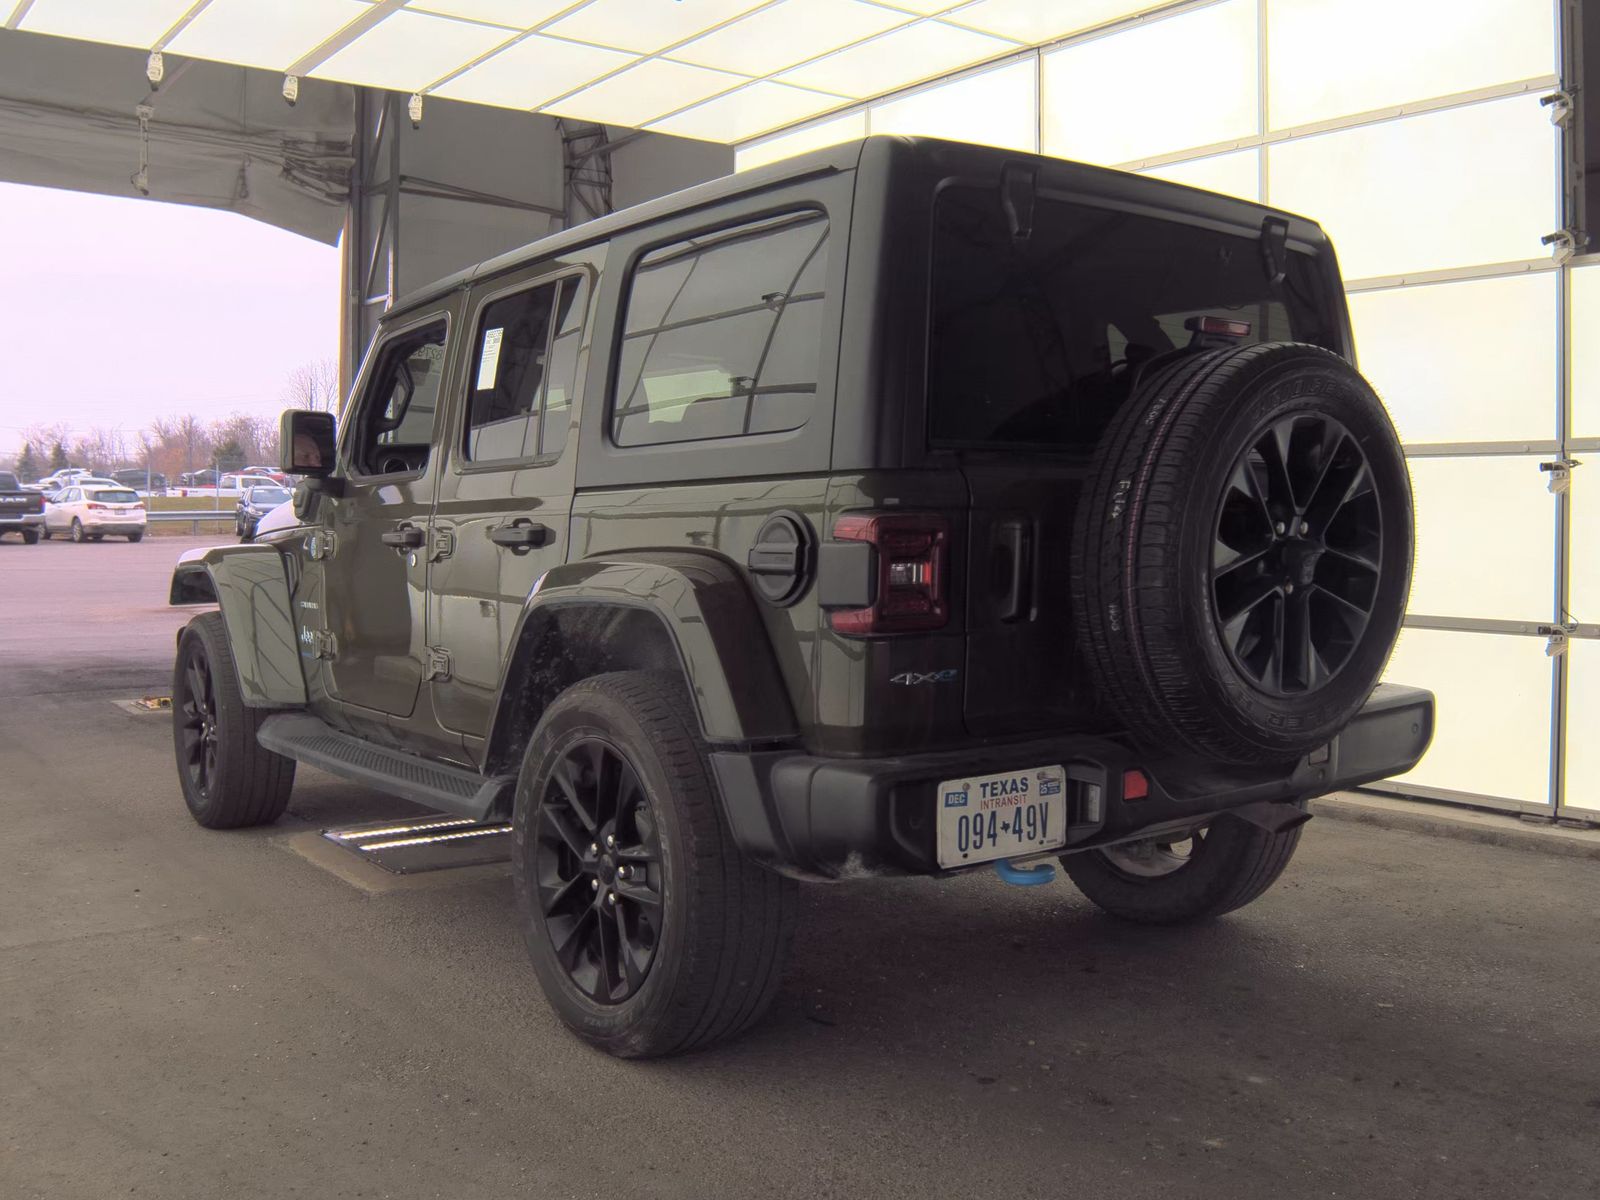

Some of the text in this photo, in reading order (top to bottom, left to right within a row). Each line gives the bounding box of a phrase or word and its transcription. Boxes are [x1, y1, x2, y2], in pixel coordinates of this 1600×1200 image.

[948, 793, 966, 805] DEC
[979, 777, 1029, 799] TEXAS
[957, 801, 1049, 853] 094 49V
